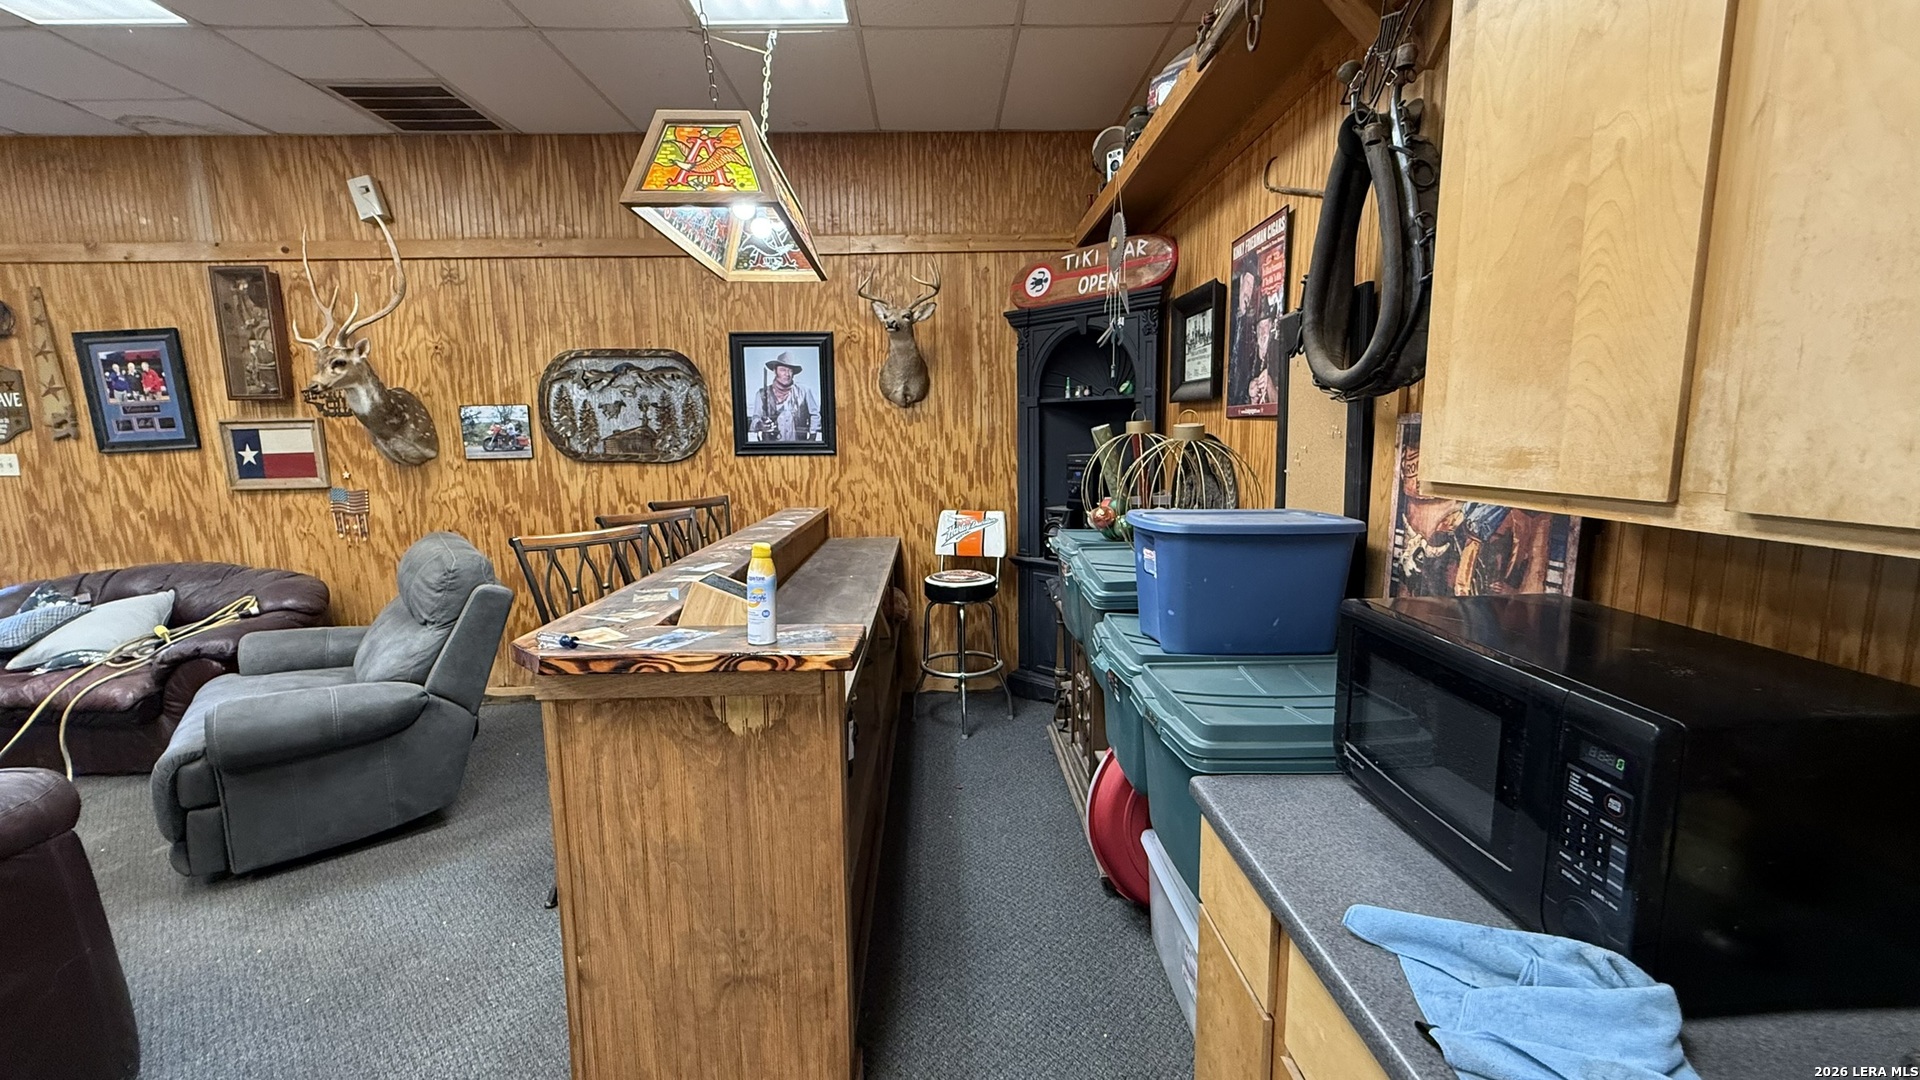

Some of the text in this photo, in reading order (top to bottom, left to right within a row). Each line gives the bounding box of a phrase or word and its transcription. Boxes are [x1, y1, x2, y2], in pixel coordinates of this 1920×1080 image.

[1061, 239, 1149, 271] TIKI AR
[1078, 271, 1120, 295] OPEN
